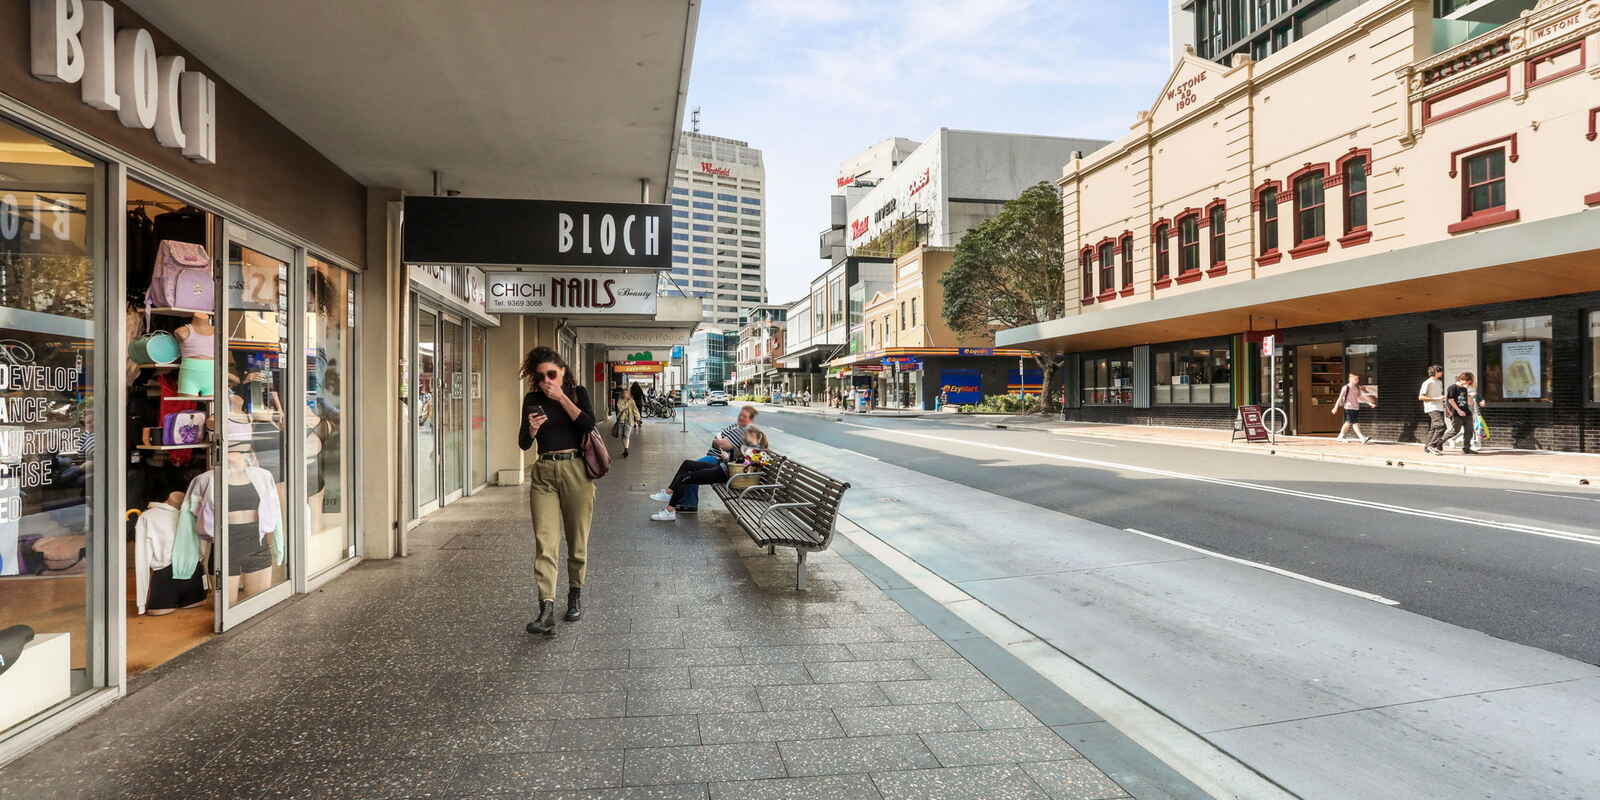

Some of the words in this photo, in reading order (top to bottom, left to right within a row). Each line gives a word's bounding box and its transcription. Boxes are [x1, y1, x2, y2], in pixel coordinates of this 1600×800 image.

[32, 0, 216, 164] BLOCH
[1166, 70, 1207, 100] W.STONE
[1176, 94, 1197, 111] 1900
[701, 161, 730, 176] Westfield
[558, 212, 660, 255] BLOCH
[491, 283, 546, 297] CHICHI
[551, 276, 617, 308] NAILS
[616, 288, 652, 300] Beauty
[0, 364, 79, 391] DEVELOP
